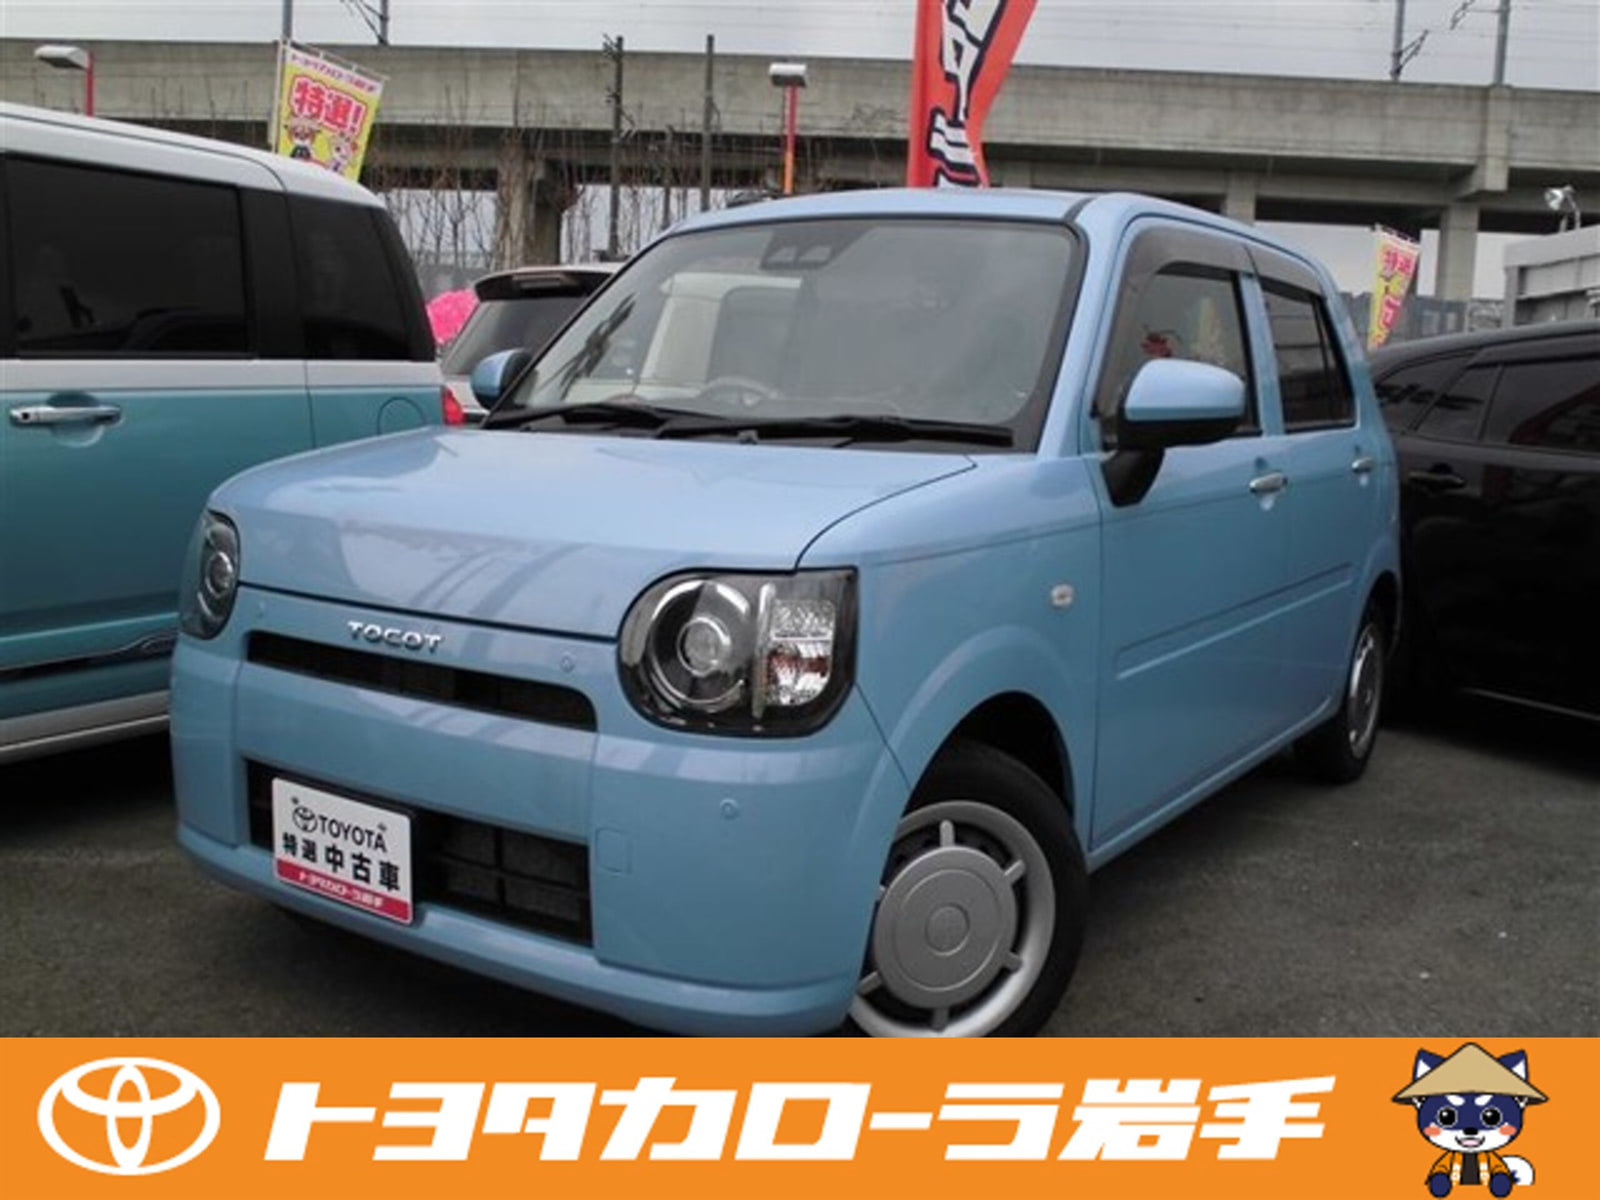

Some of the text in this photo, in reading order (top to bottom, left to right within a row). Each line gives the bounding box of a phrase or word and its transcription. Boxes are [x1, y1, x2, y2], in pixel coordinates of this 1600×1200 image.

[347, 621, 442, 653] TOCOT
[318, 815, 387, 852] TOYOTA
[282, 832, 400, 891] 特選中古車
